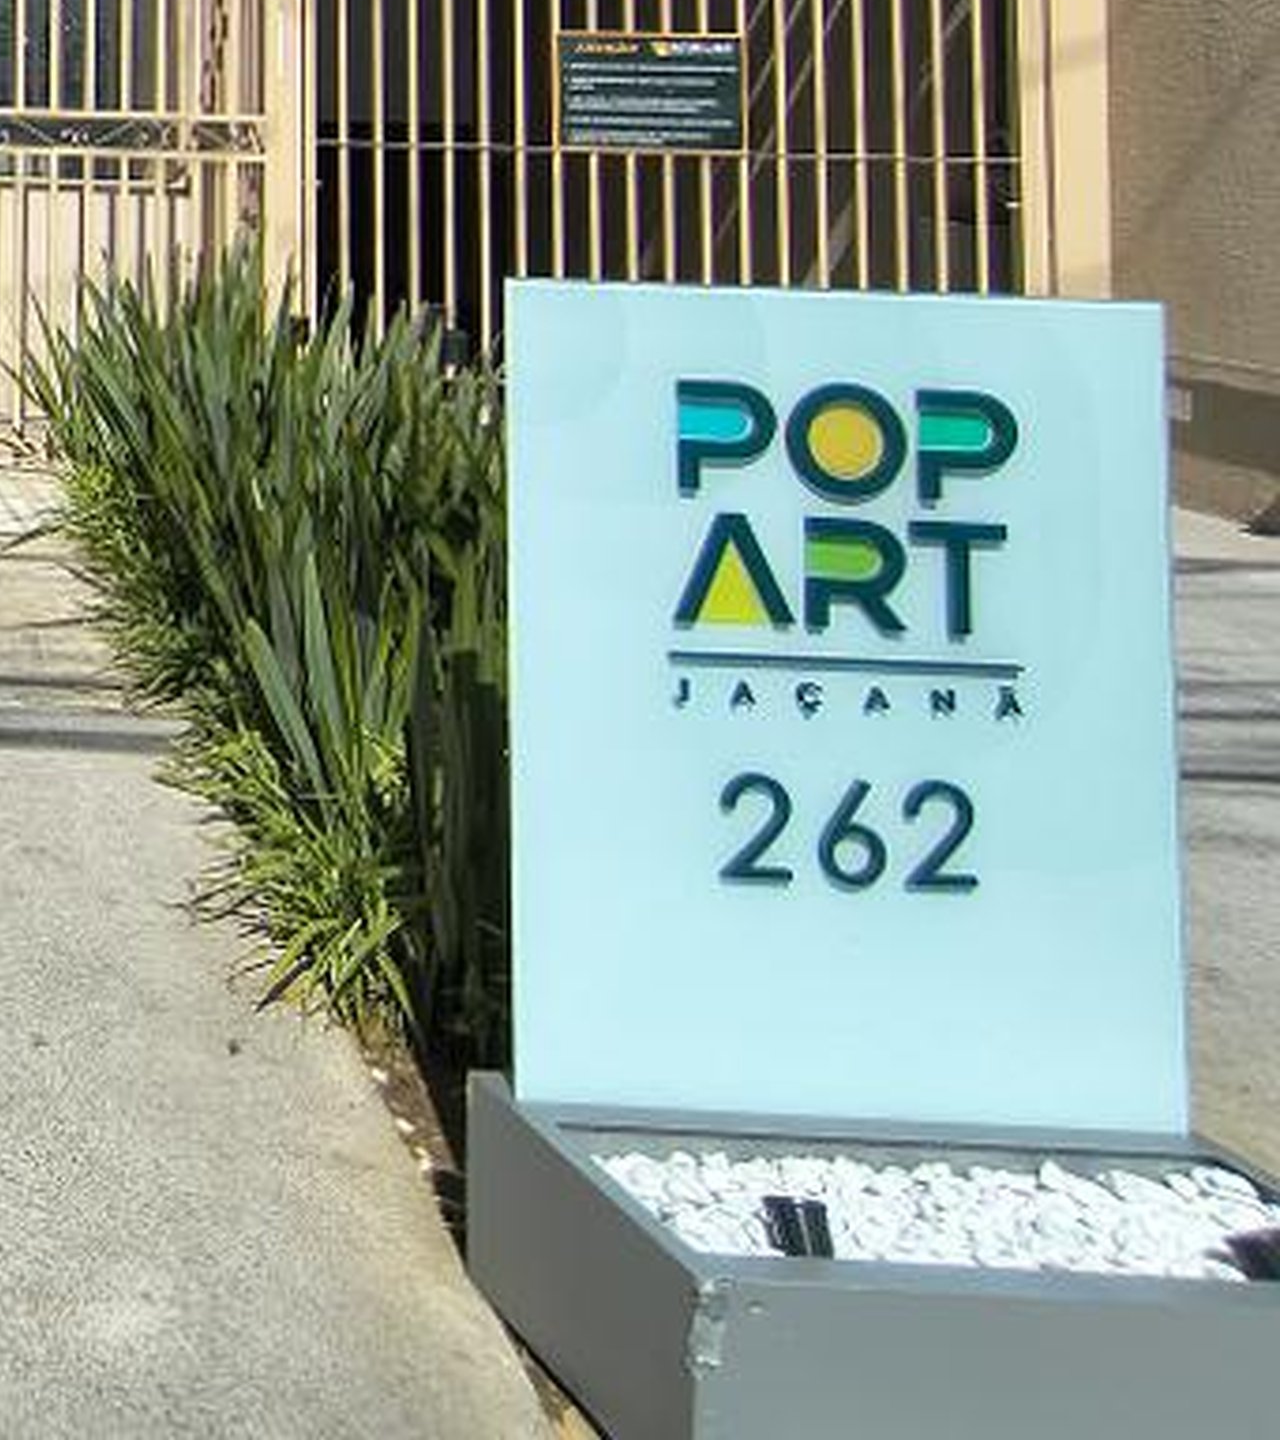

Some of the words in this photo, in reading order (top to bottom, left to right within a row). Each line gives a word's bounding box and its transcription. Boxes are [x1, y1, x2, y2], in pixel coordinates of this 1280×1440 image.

[674, 379, 1019, 508] POP
[672, 511, 1009, 644] ART
[672, 677, 1026, 721] JAÇANÃ
[718, 771, 980, 894] 262
